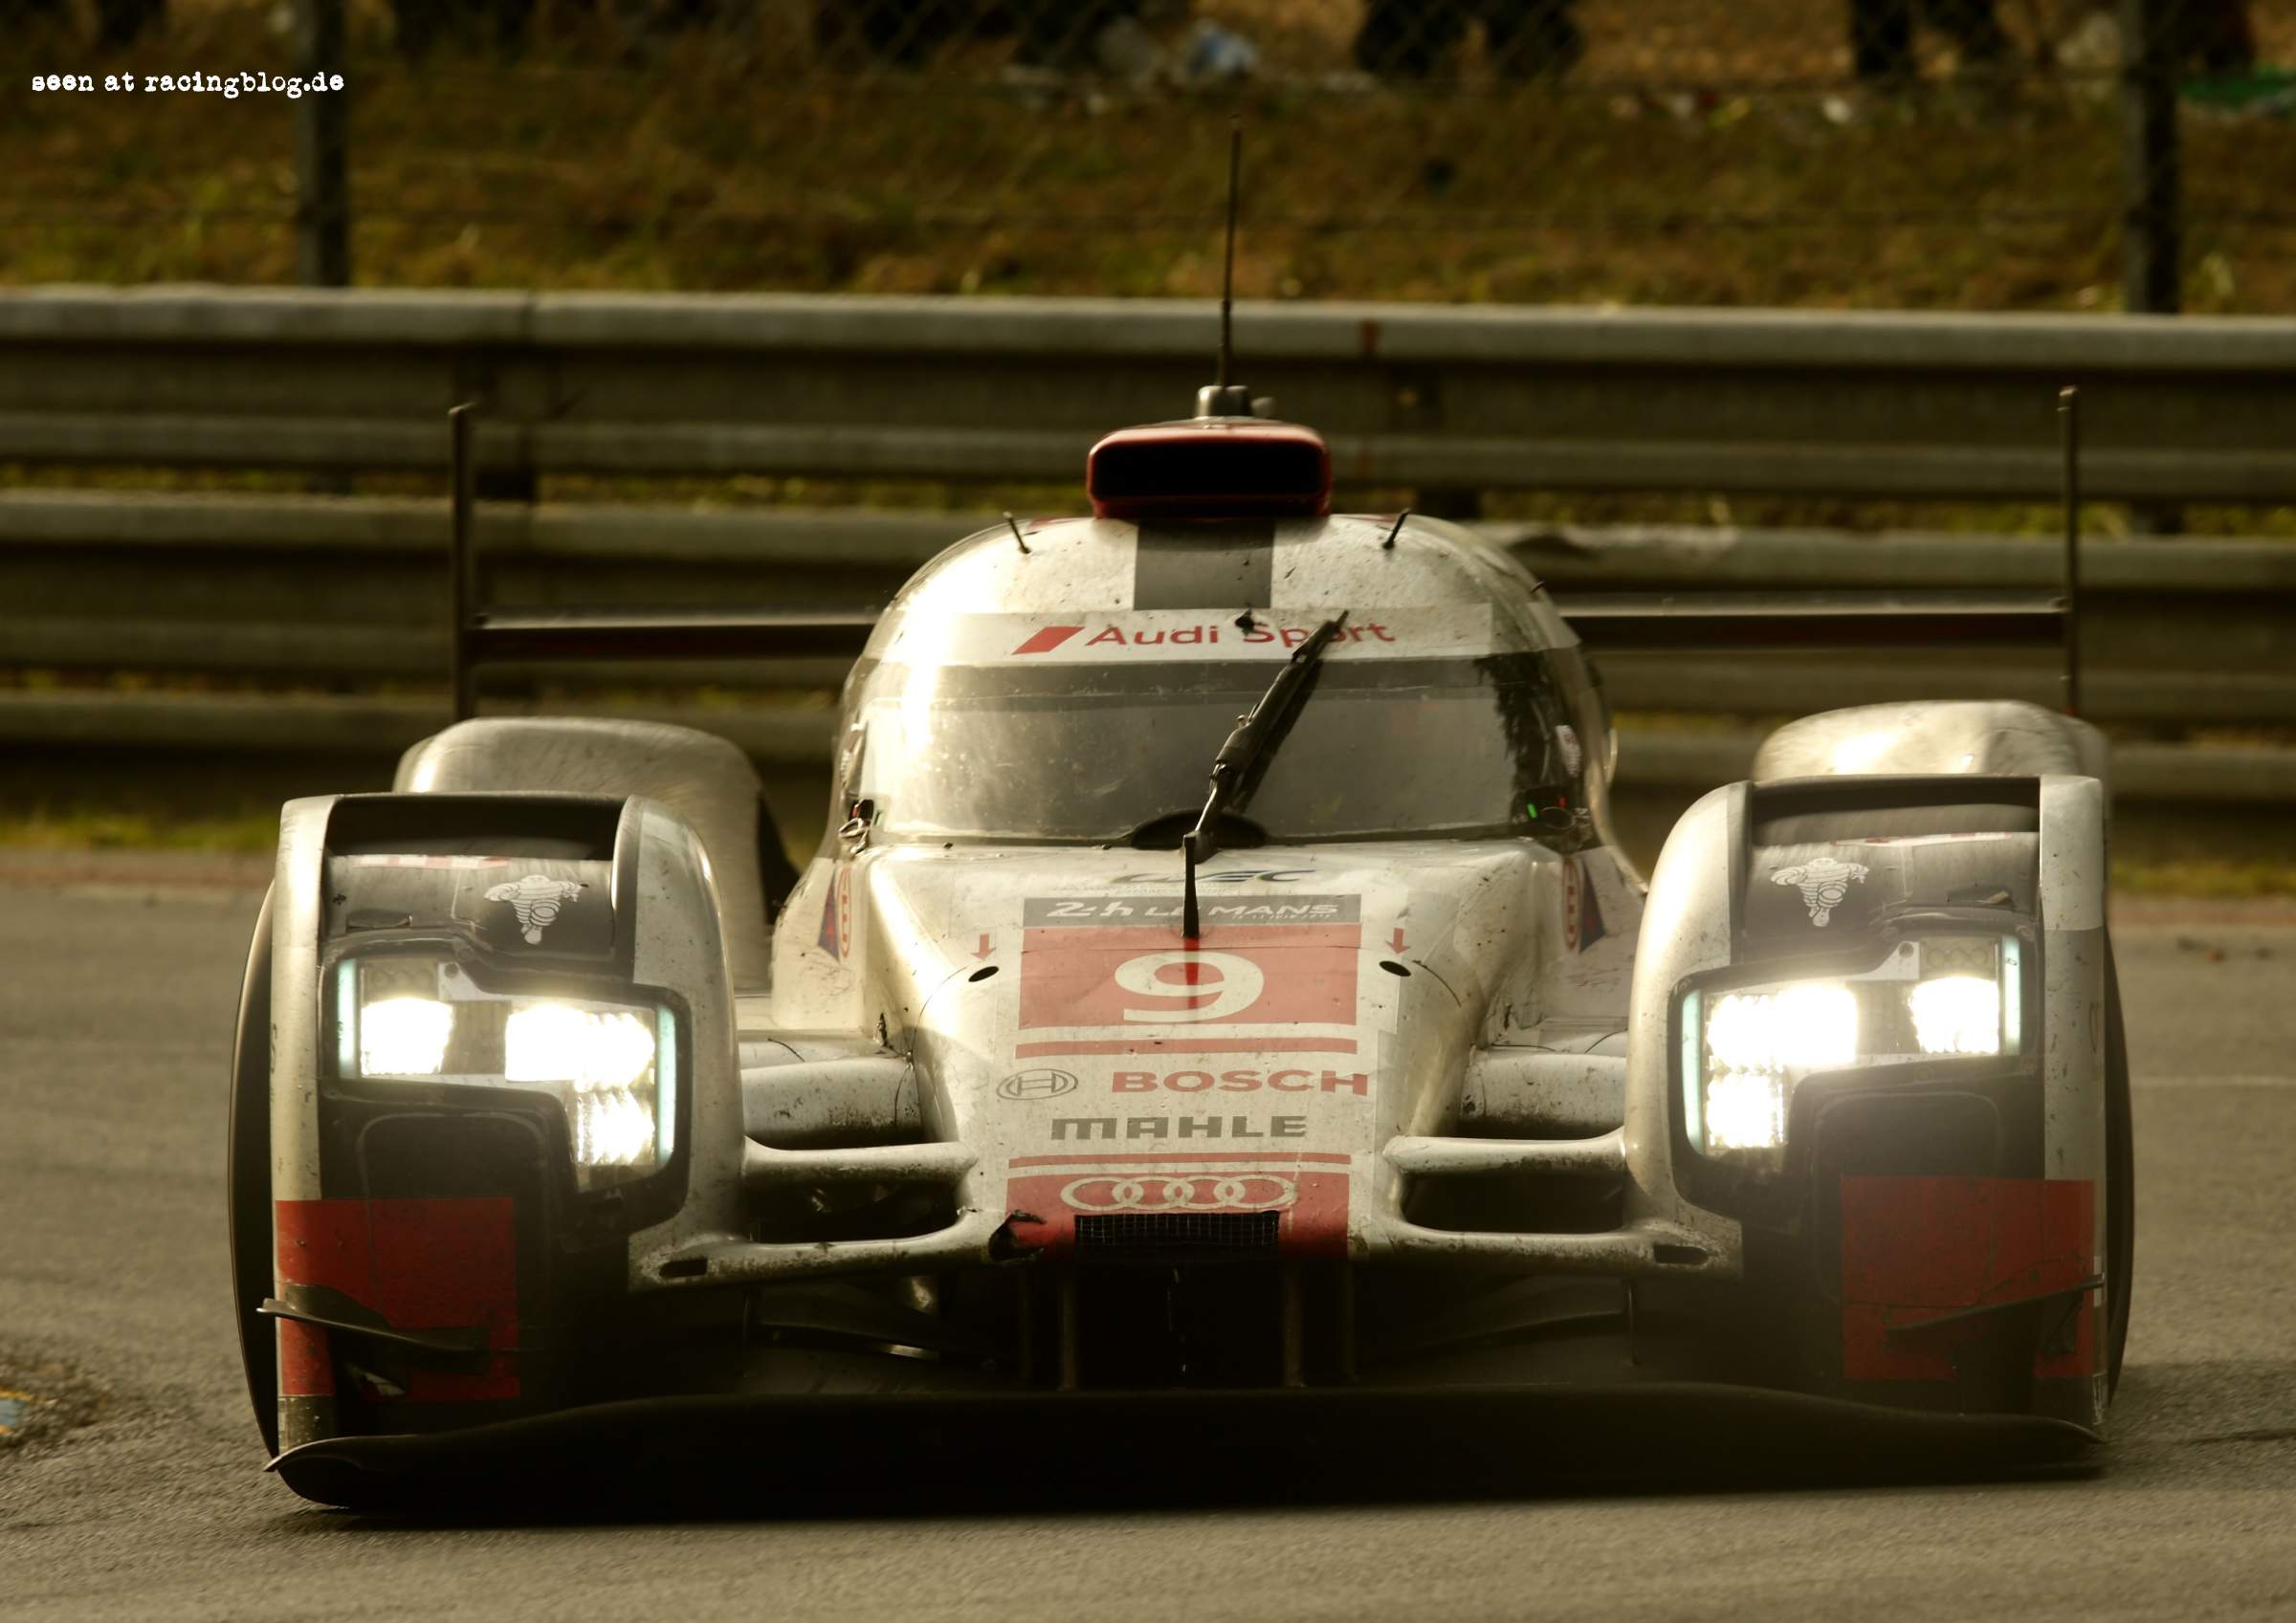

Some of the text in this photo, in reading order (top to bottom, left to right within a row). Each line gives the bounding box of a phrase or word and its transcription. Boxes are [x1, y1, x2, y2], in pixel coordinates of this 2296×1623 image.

[1085, 625, 1220, 646] Audi
[1207, 904, 1339, 915] MANS
[1115, 952, 1265, 1022] 9
[1112, 1069, 1368, 1096] BOSCH
[1051, 1115, 1307, 1140] MAHLE
